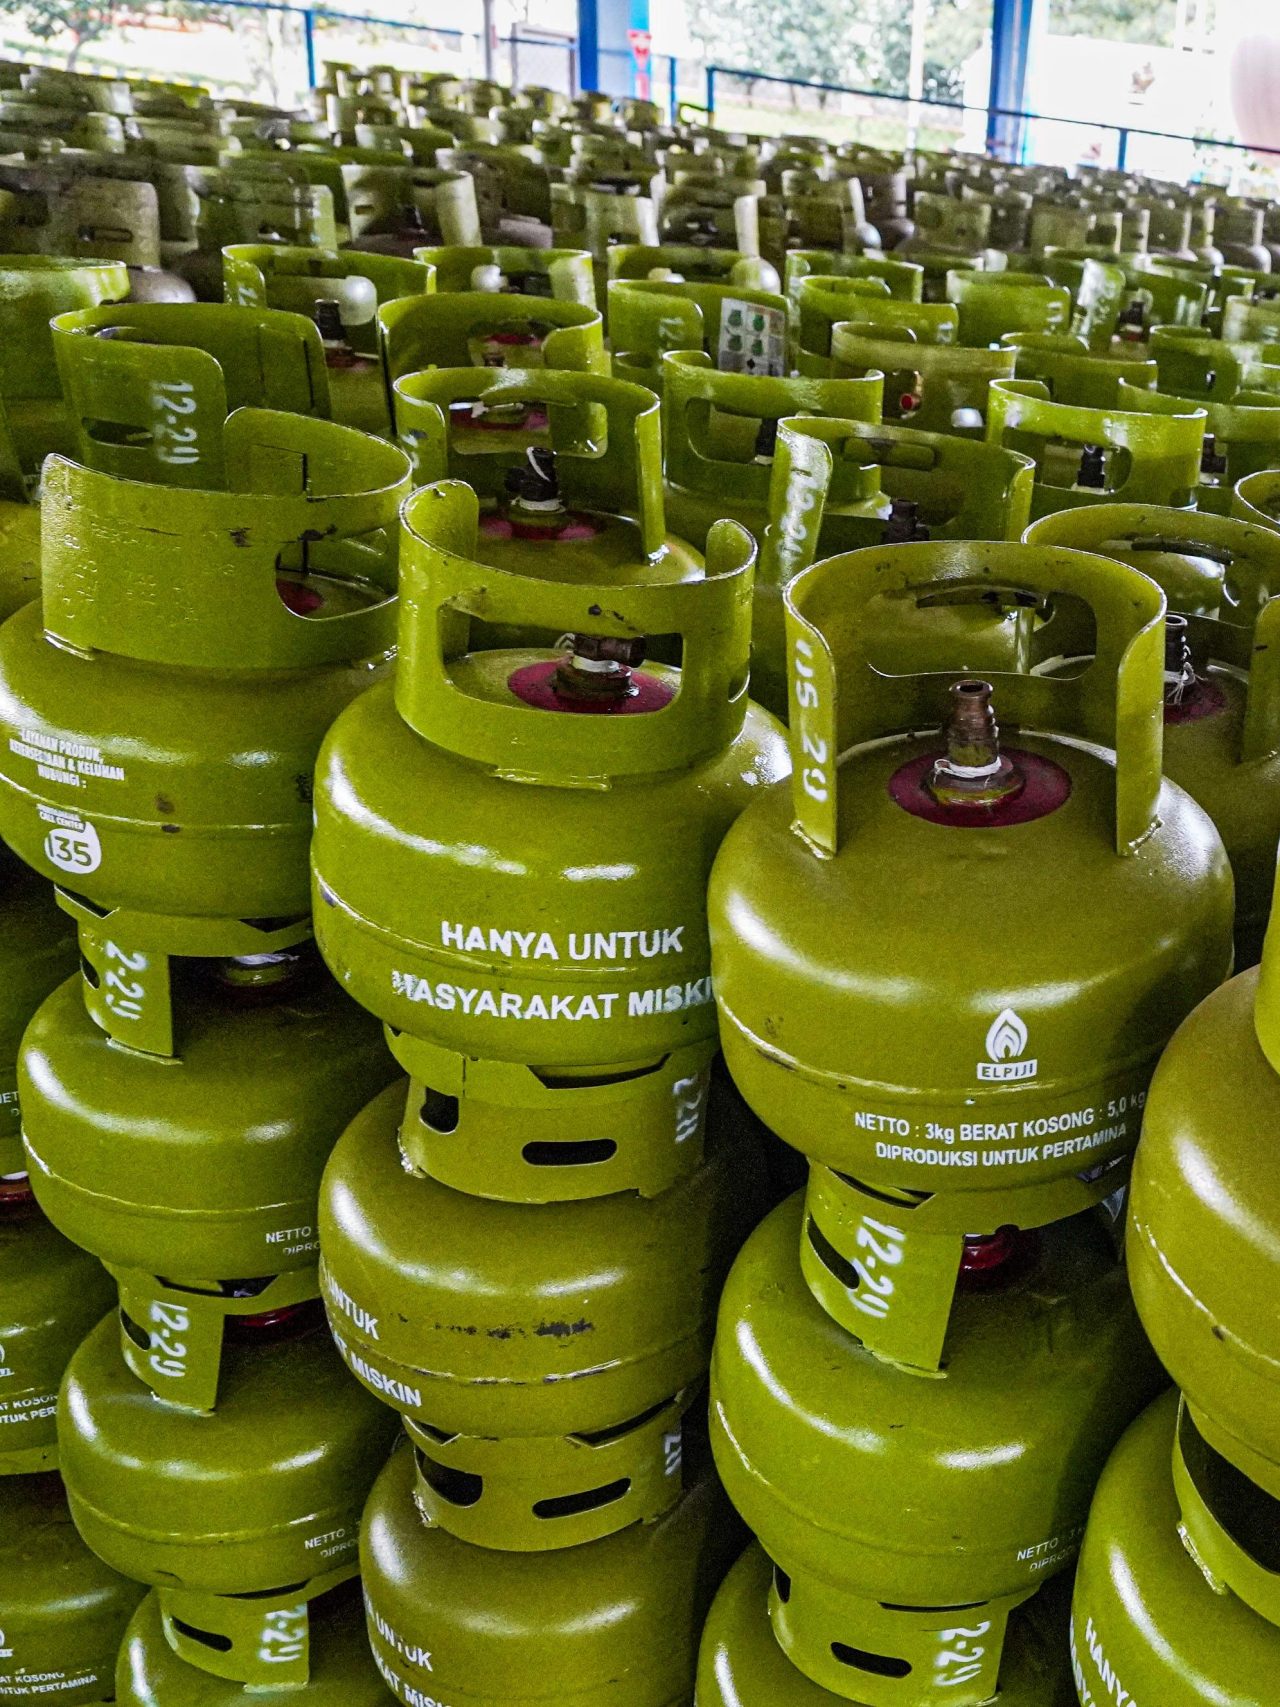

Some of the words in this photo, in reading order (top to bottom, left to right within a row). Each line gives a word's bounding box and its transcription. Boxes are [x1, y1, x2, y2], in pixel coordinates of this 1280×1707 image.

[48, 834, 92, 867] 135
[441, 920, 559, 960] HANYA
[568, 926, 684, 960] UNTUK
[392, 969, 619, 1020] MASYARAKAT
[628, 975, 712, 1017] MISKI
[981, 1064, 1034, 1079] ELPIJI
[855, 1112, 910, 1137] NETTO
[925, 1122, 955, 1145] 3kg
[960, 1122, 1019, 1141] BERAT
[1023, 1107, 1095, 1138] KOSONG
[875, 1142, 977, 1167] DIPRODUKSI
[982, 1149, 1039, 1166] UNTUK
[1042, 1122, 1127, 1160] PERTAMINA
[265, 1226, 312, 1244] NETTO
[351, 1352, 422, 1408] MISKIN
[304, 1528, 346, 1549] NETTO
[1016, 1537, 1059, 1561] NETTO
[31, 1674, 98, 1694] PERTAMINA
